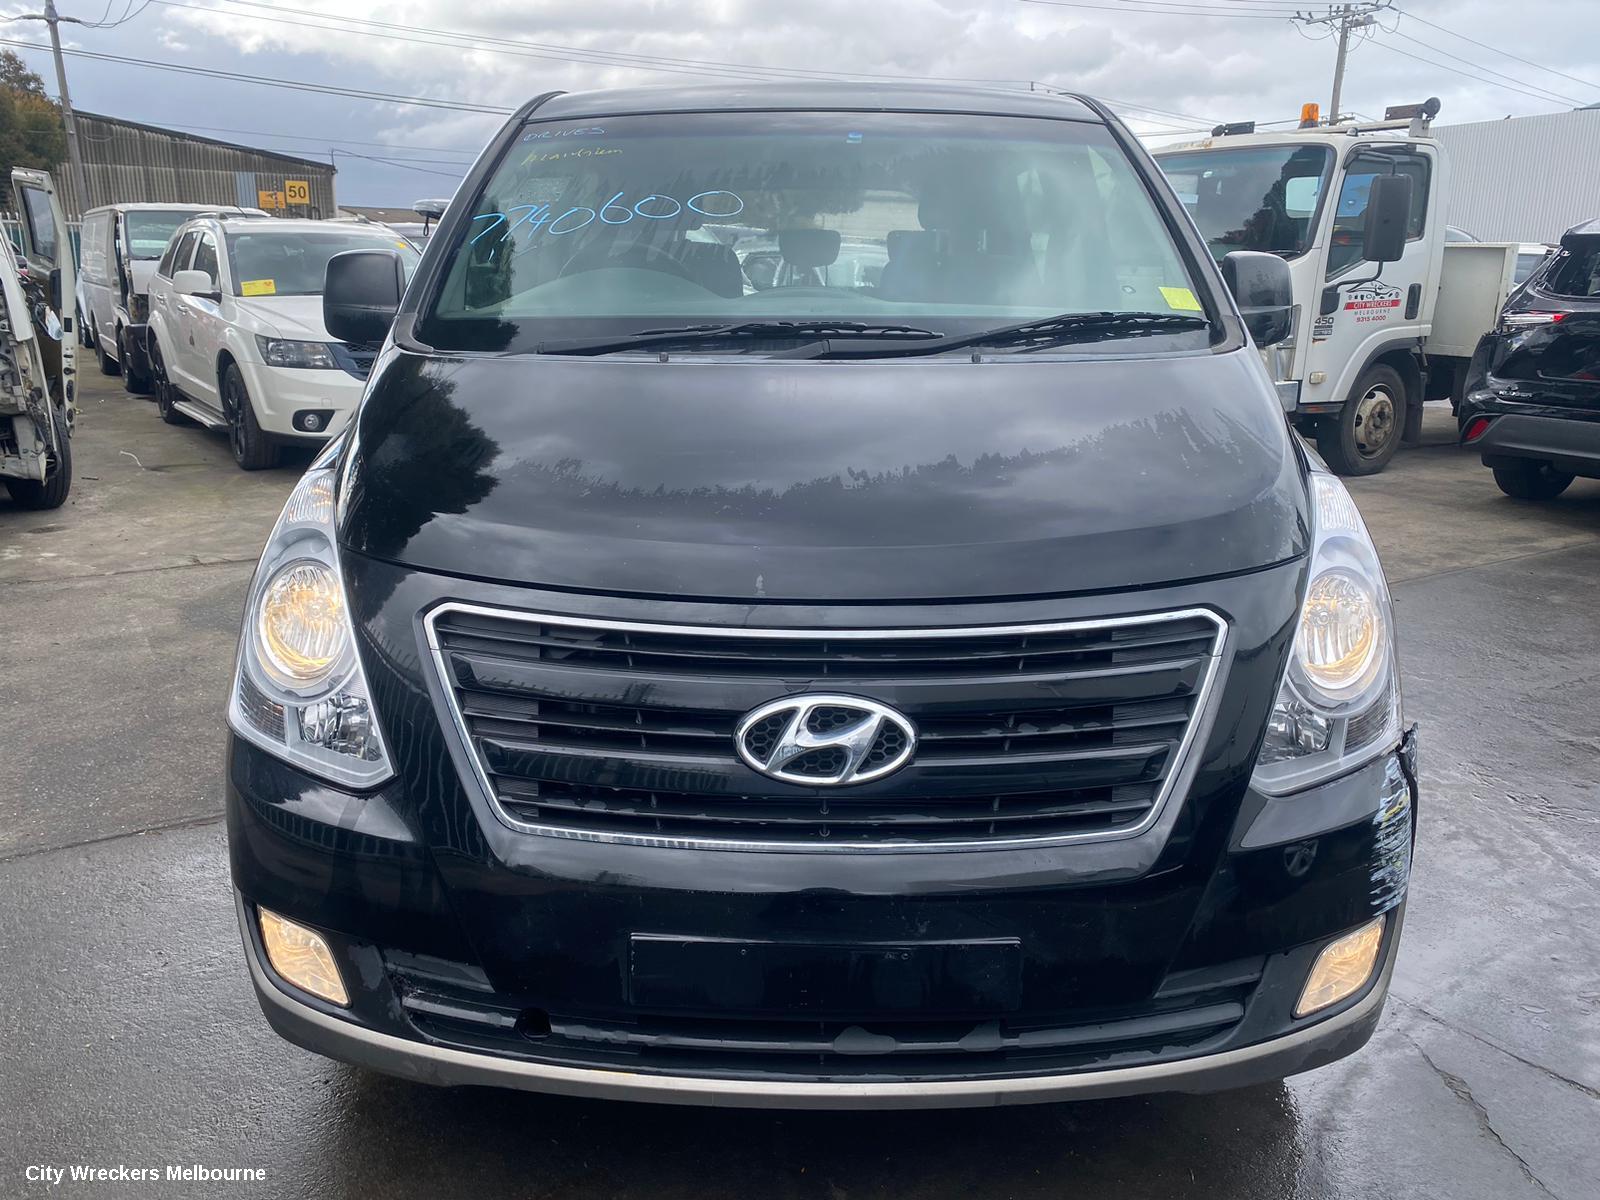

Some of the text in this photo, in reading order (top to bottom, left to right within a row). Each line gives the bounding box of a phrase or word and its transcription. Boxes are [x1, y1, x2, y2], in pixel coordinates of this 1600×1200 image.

[288, 185, 307, 199] 50
[470, 190, 744, 245] 7740600
[1366, 299, 1392, 308] WRECKERS
[1314, 316, 1334, 325] 450
